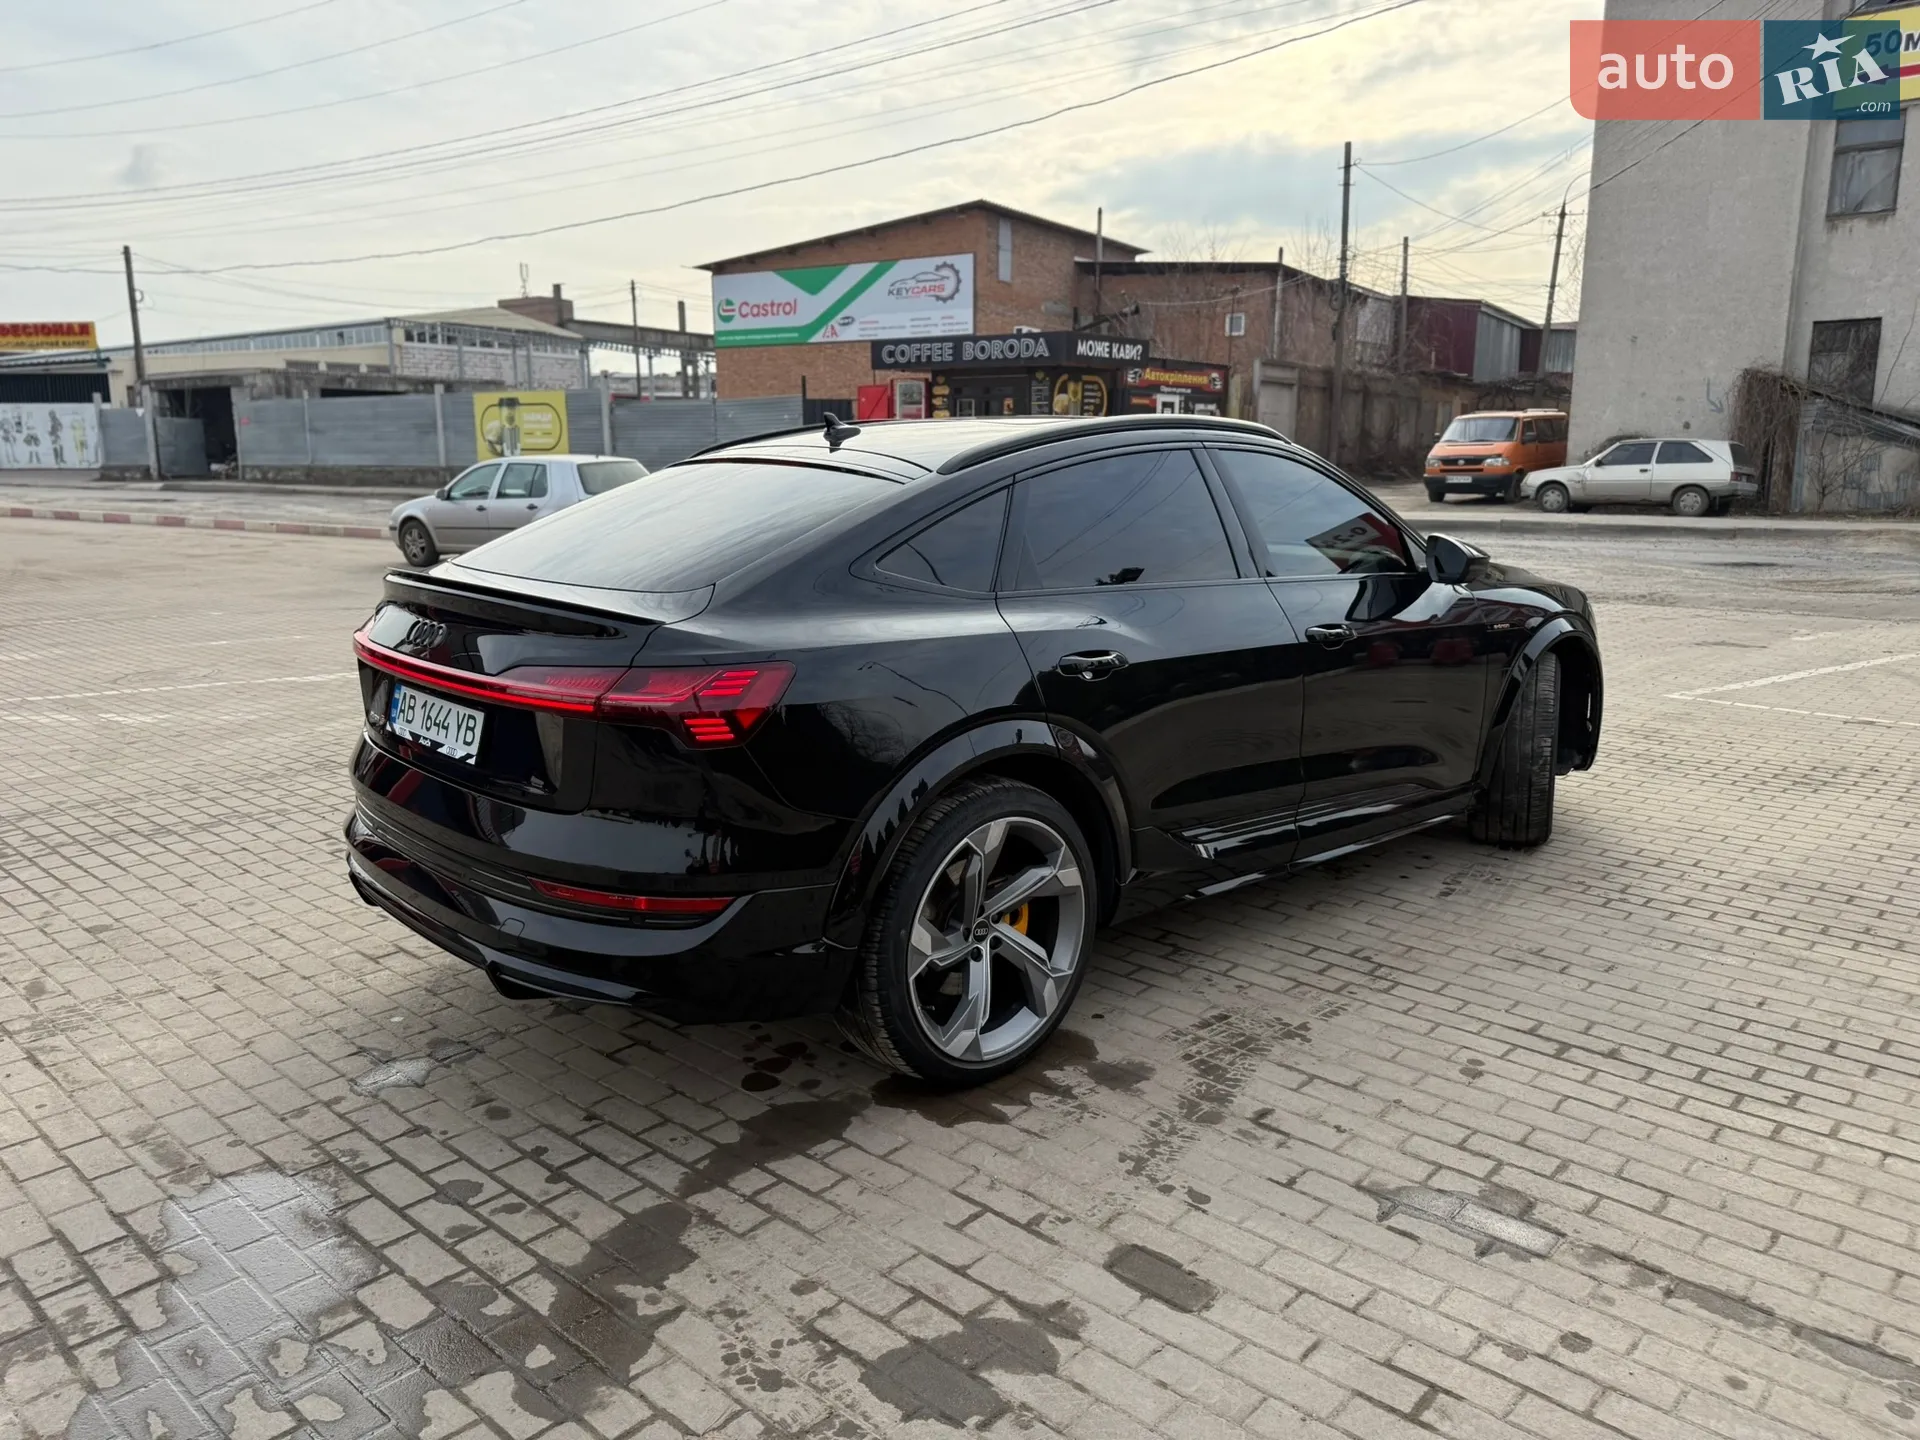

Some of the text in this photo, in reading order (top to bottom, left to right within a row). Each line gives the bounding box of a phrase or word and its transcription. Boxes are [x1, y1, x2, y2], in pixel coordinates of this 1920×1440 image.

[887, 283, 946, 298] KEYCARS
[738, 298, 798, 319] Castrol
[881, 337, 1051, 364] COFFEE BORODA
[1076, 339, 1143, 361] МОЖЕ КАВИ?
[1143, 366, 1209, 386] Автокріплення
[398, 692, 417, 724] AB
[420, 700, 452, 739] 1644
[456, 710, 477, 747] YB
